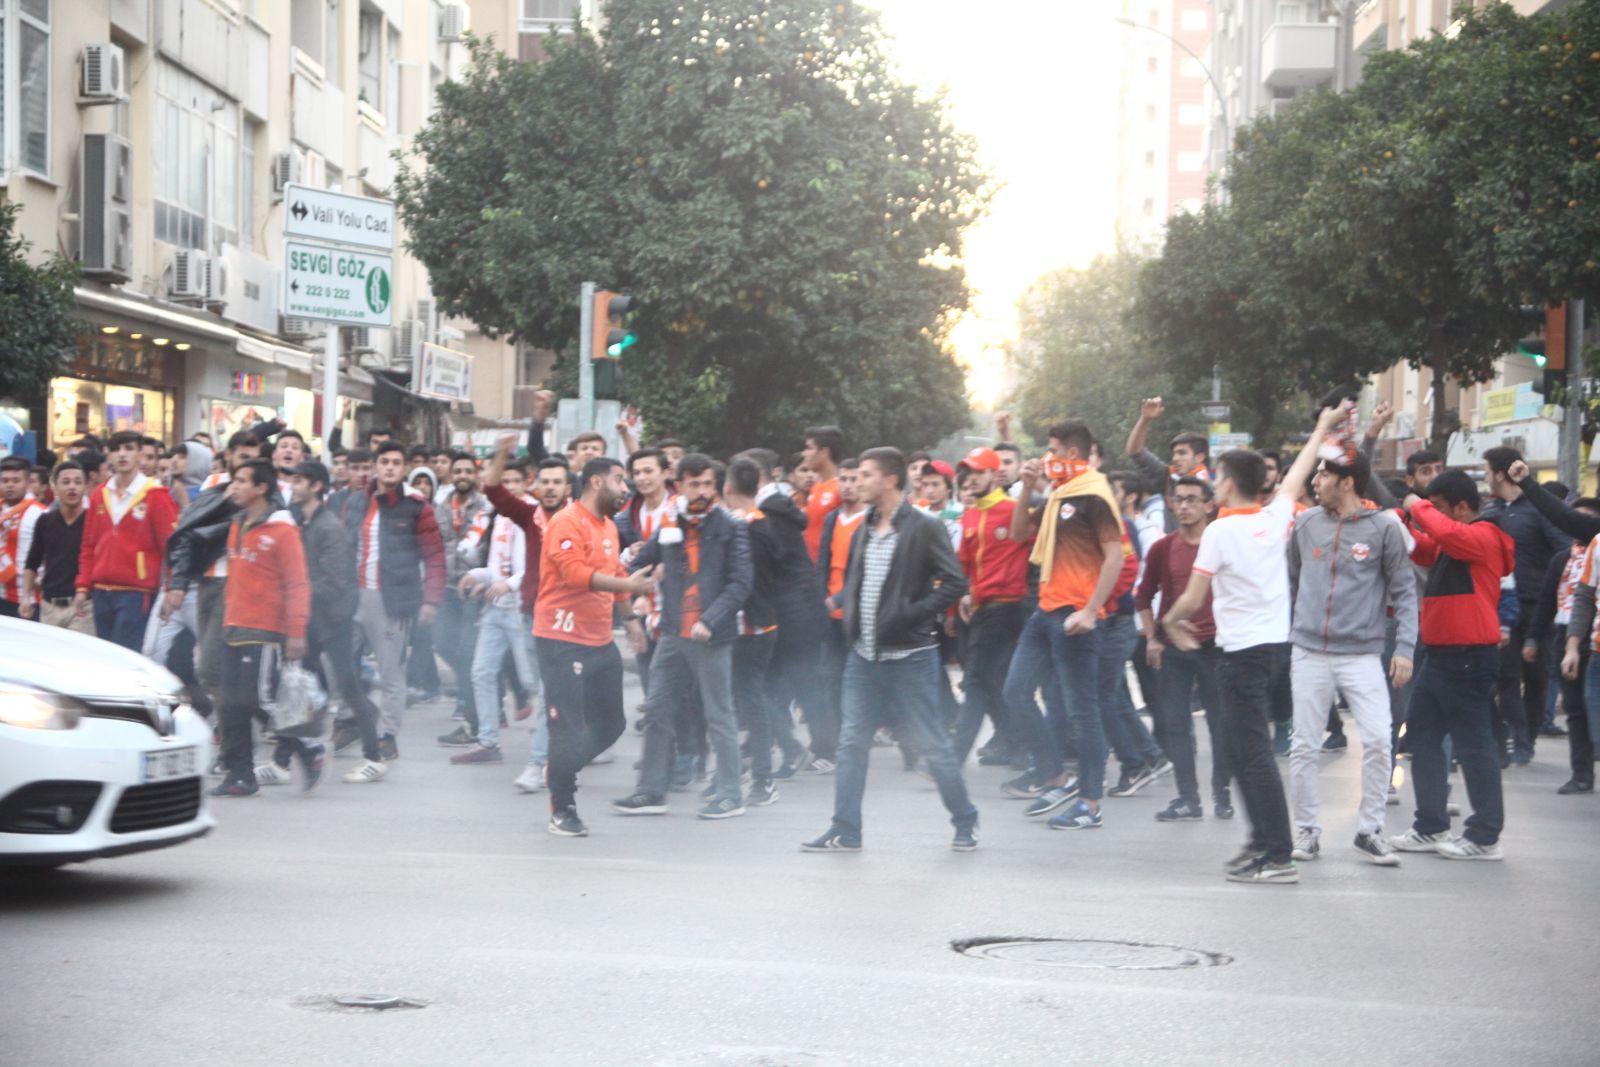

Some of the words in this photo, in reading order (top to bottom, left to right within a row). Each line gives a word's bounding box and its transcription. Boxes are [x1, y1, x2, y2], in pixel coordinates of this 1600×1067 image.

[312, 204, 334, 224] Vali
[337, 209, 362, 229] Yolu
[365, 214, 391, 233] Cad.
[290, 250, 332, 275] SEVGİ
[337, 255, 366, 279] GÖZ
[305, 284, 323, 297] 222
[333, 287, 351, 300] 222
